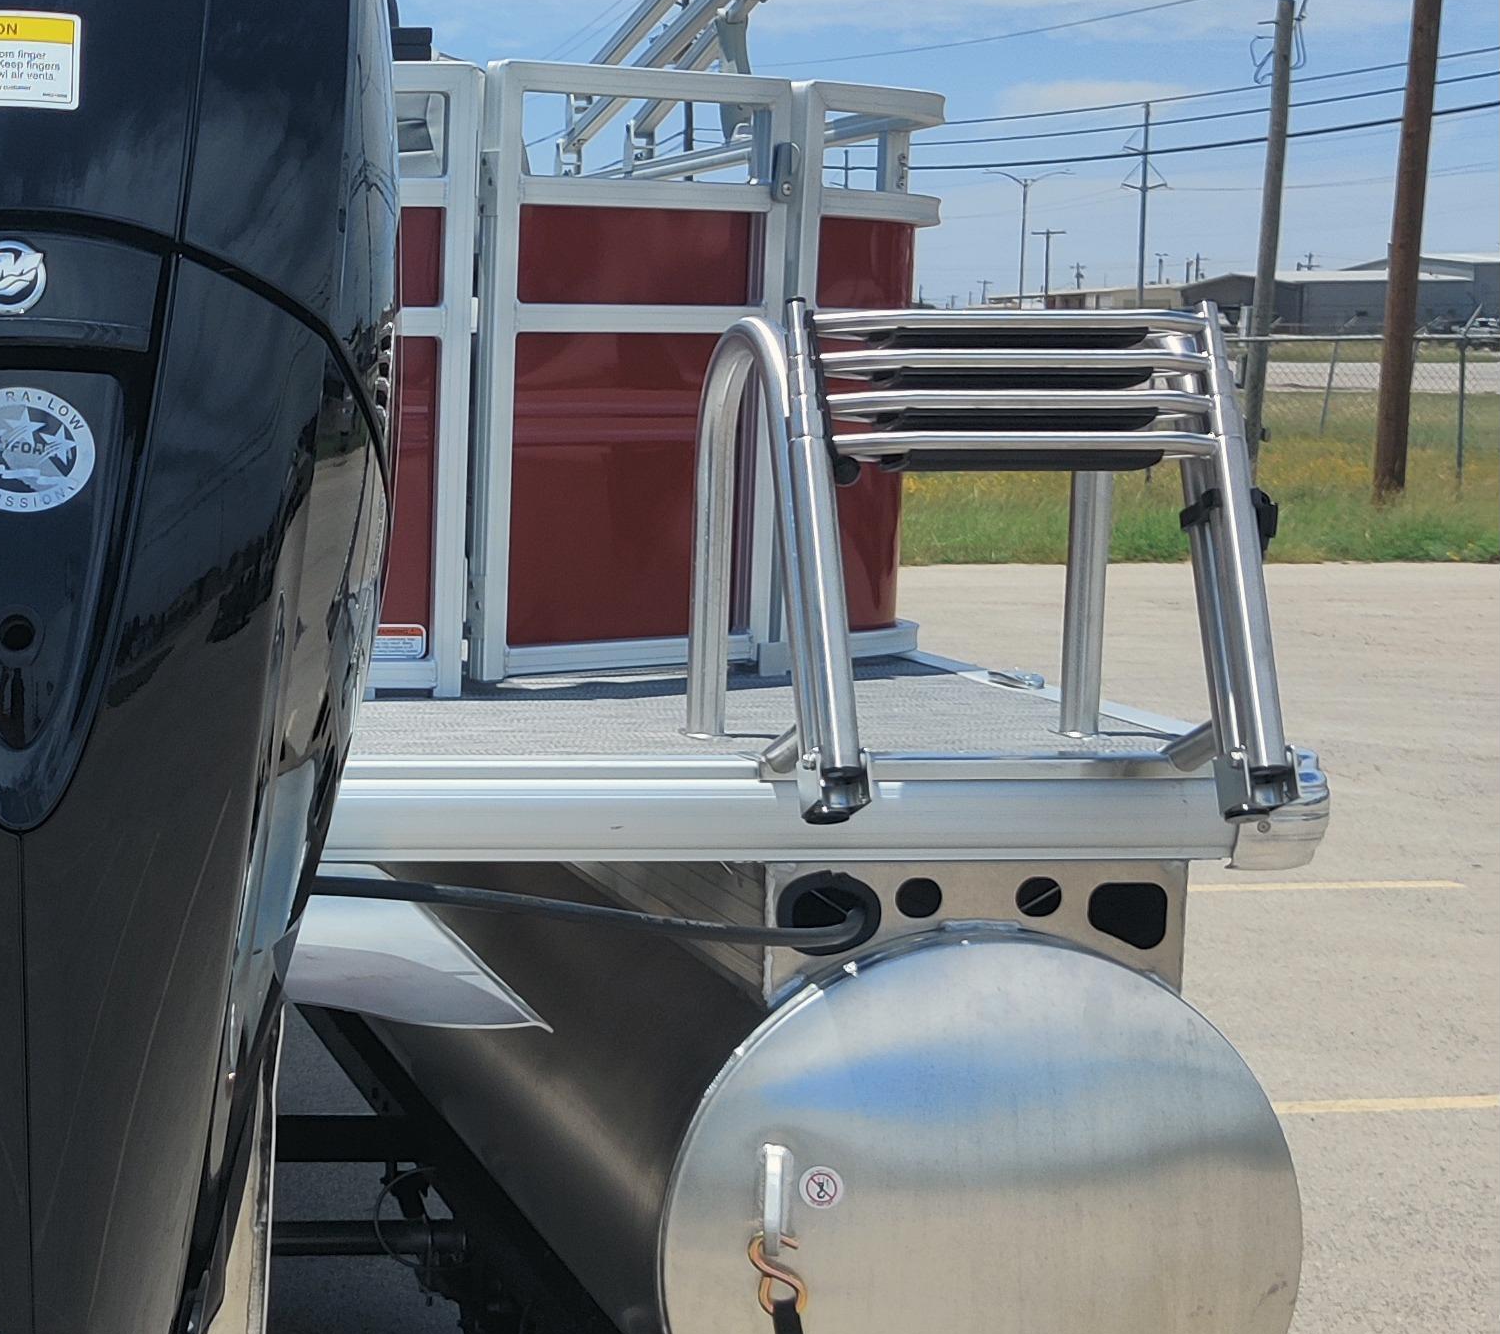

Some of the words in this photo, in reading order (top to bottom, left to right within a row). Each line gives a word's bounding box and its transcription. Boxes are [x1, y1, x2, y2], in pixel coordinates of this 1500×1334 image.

[18, 49, 46, 61] finger
[26, 61, 60, 72] fingers
[11, 70, 24, 79] air
[48, 398, 84, 431] LOW
